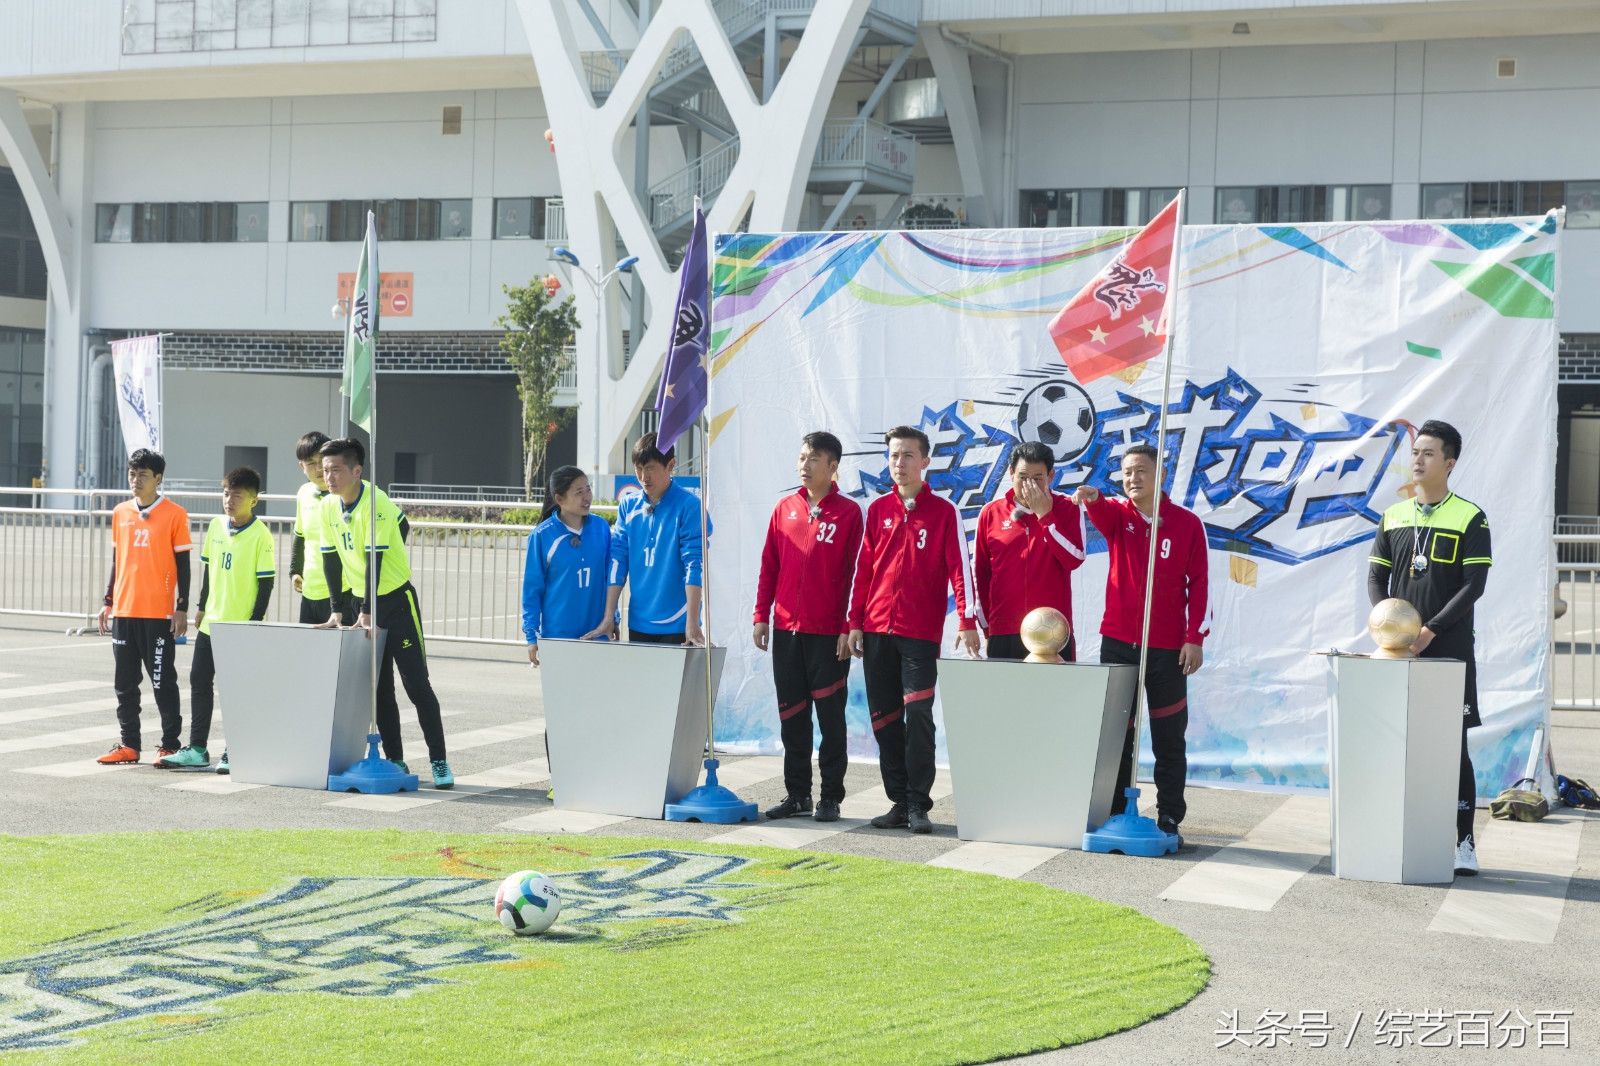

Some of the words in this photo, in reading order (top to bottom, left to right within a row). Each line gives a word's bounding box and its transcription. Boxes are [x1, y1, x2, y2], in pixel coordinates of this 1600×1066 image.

[133, 528, 149, 547] 22
[341, 531, 354, 550] 15
[816, 521, 837, 544] 32
[916, 528, 928, 550] 3
[1160, 538, 1172, 559] 9
[221, 551, 232, 570] 18
[576, 567, 591, 589] 17
[153, 647, 163, 690] KELME
